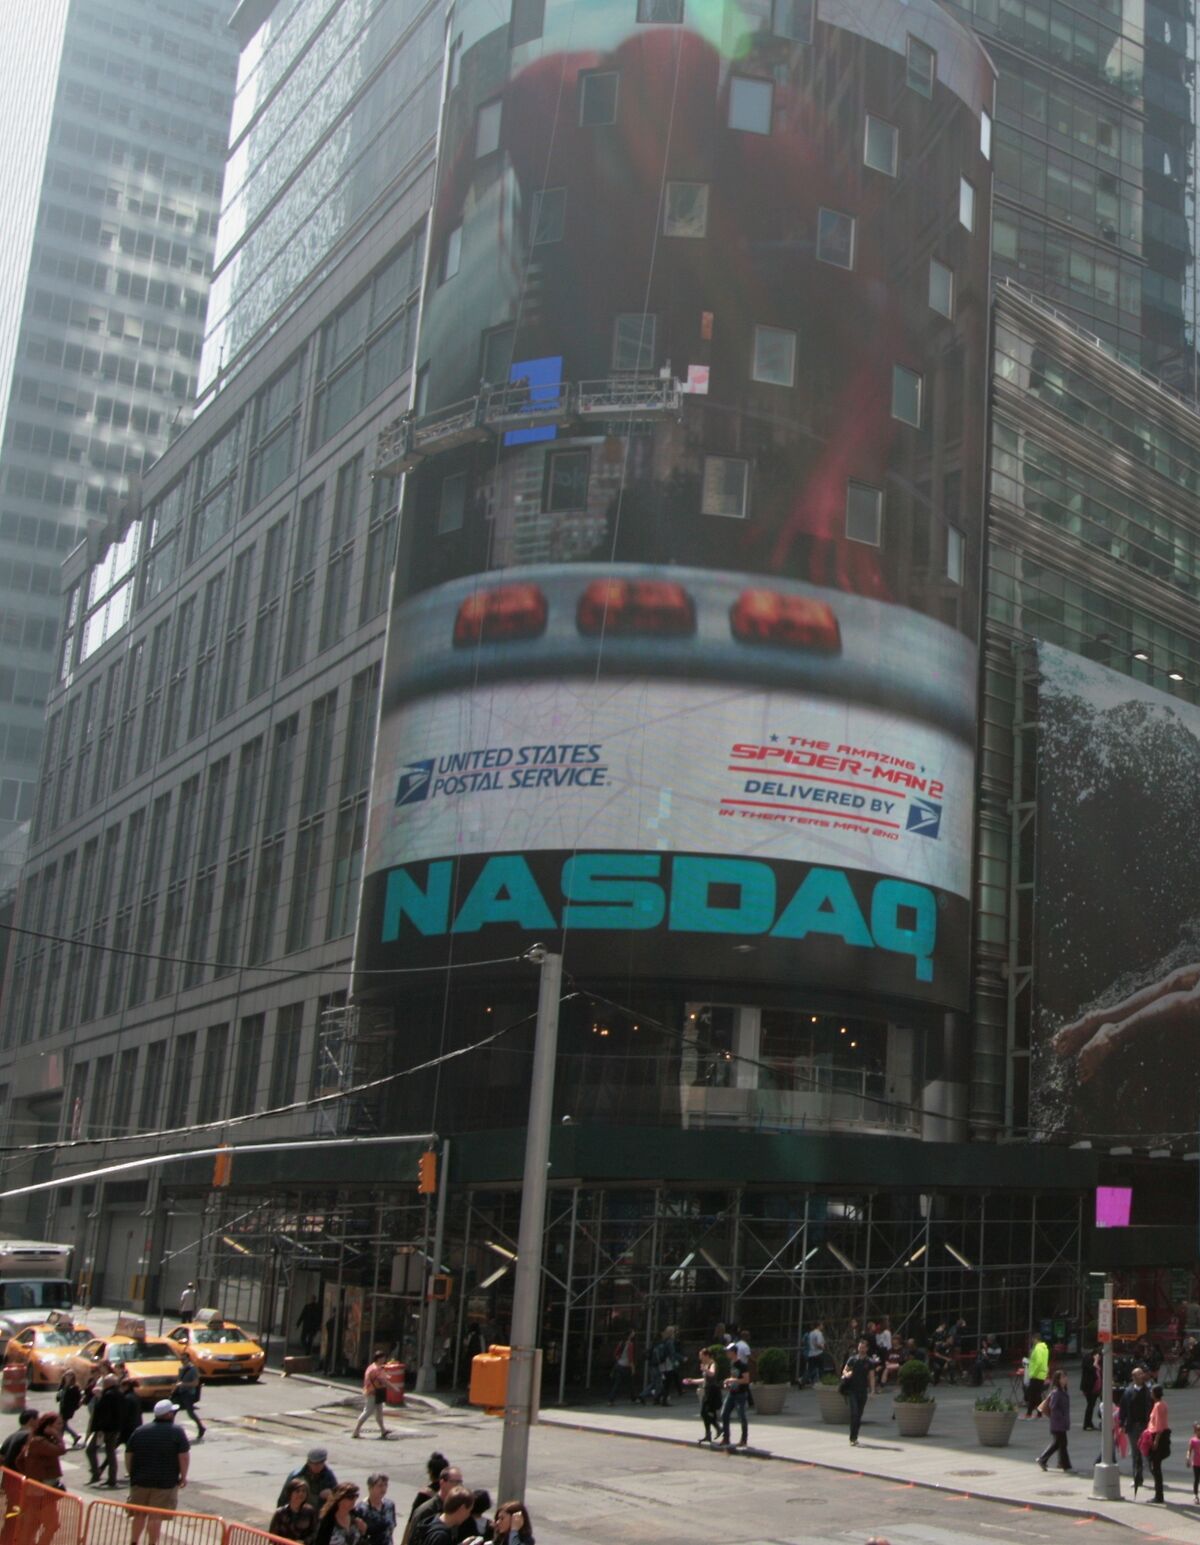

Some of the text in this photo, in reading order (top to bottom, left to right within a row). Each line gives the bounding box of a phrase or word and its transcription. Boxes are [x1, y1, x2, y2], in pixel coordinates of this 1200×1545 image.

[438, 744, 602, 775] UNITED STATES
[788, 735, 917, 771] THE AMAZING
[432, 770, 505, 798] POSTAL
[730, 744, 944, 800] SPIDER-MAN 2
[745, 780, 895, 815] DELIVERED BY
[719, 808, 898, 841] IN THEATERS MAY 2ND
[381, 852, 938, 983] NASDAQ
